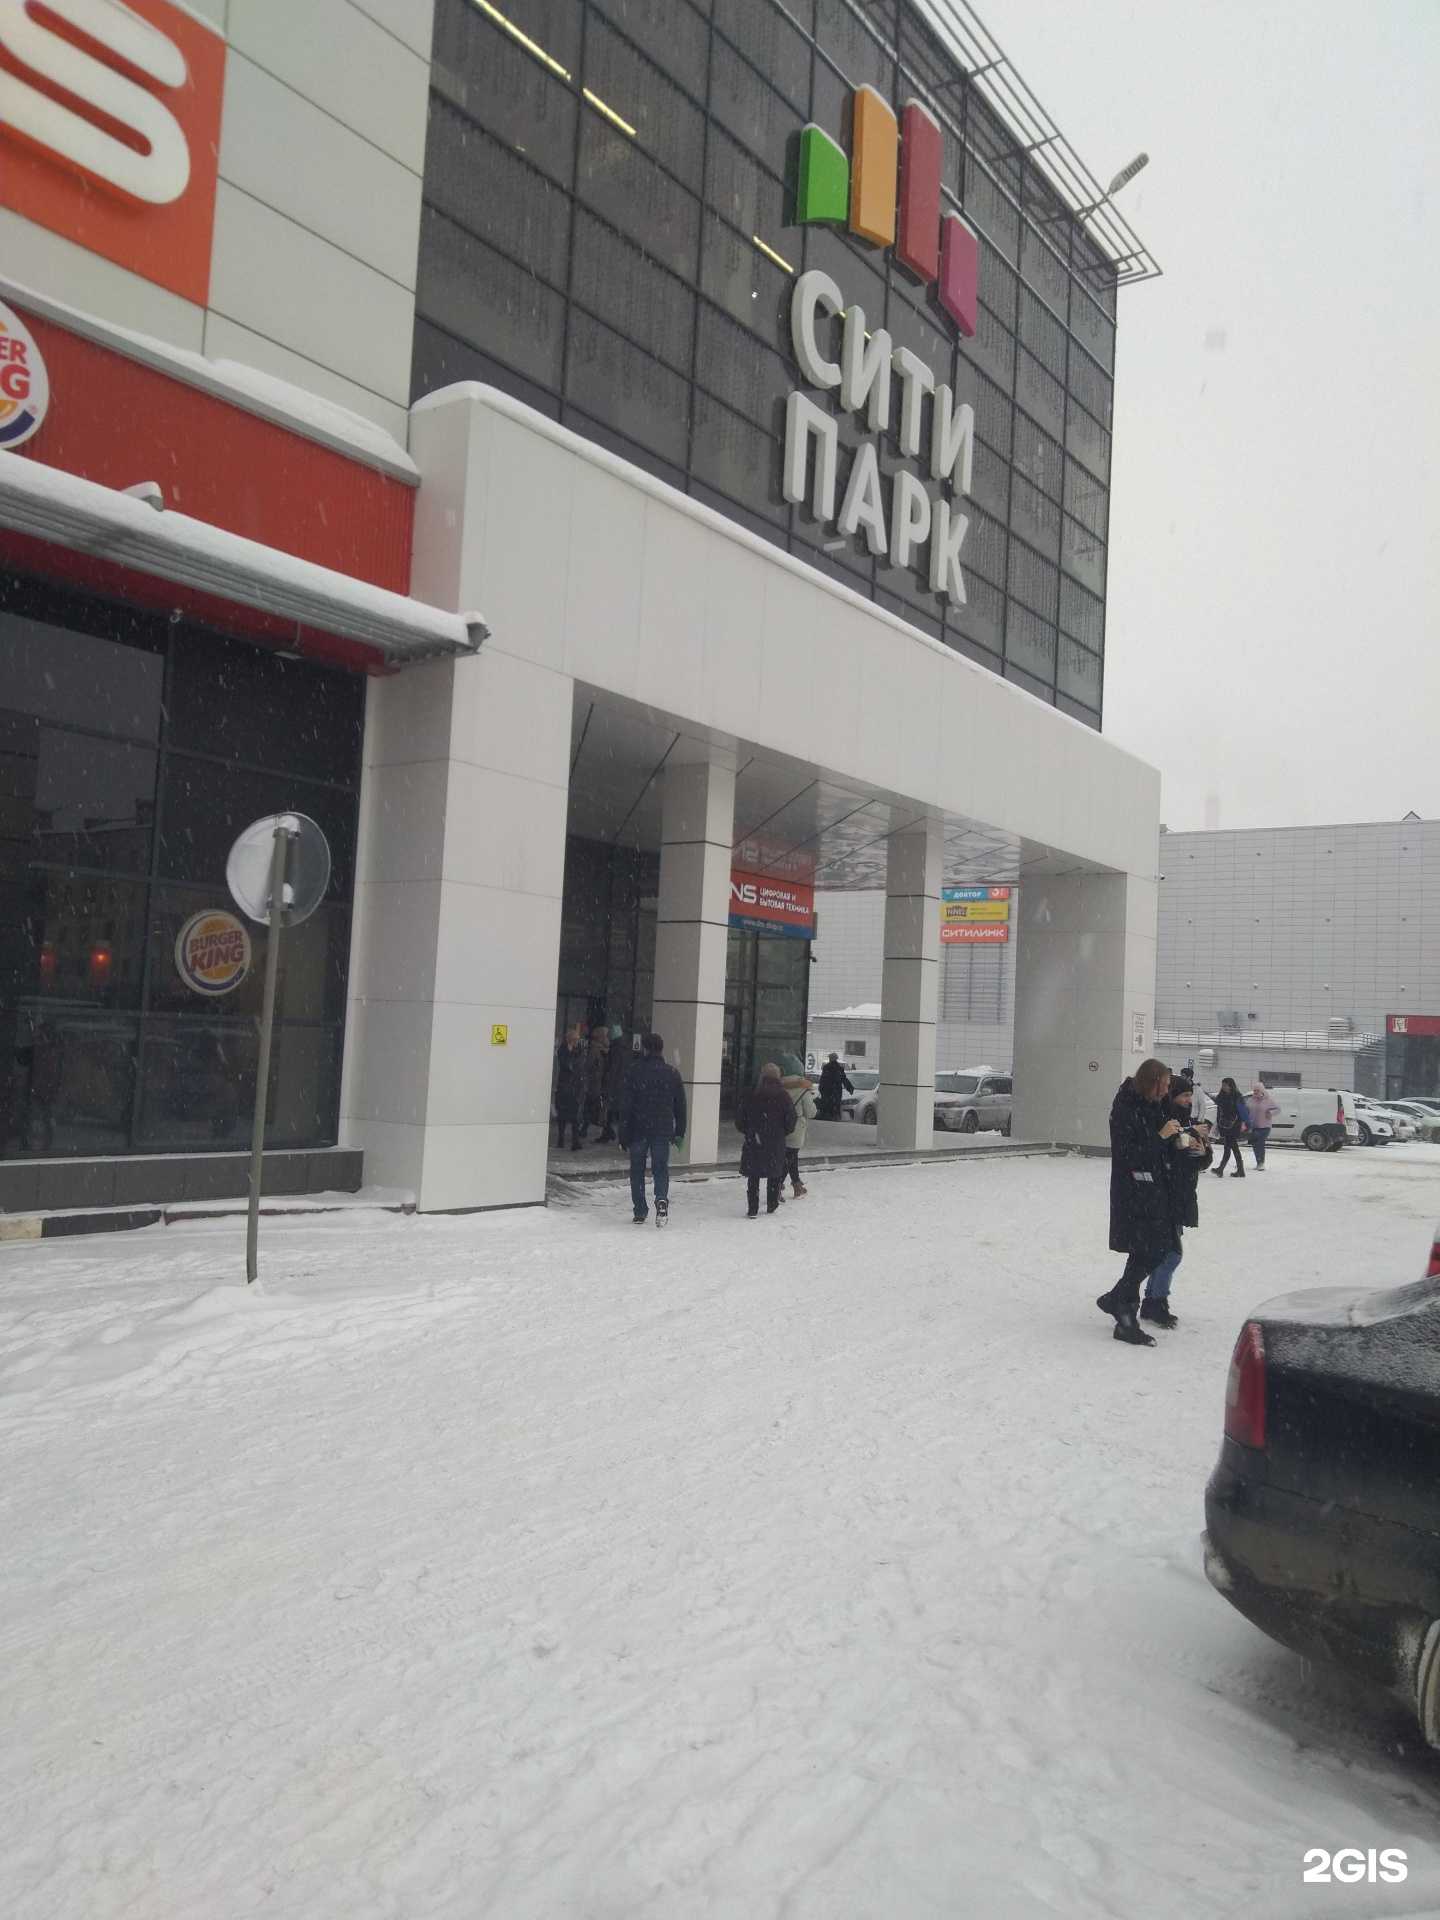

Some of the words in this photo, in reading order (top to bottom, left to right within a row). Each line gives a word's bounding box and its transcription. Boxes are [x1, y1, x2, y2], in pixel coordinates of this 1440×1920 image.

[791, 270, 974, 497] СИТИ
[783, 391, 968, 606] ПАРК
[729, 880, 757, 904] NS
[190, 930, 243, 952] BURGER
[942, 928, 1005, 937] СИТИЛИНК
[190, 944, 244, 971] KING
